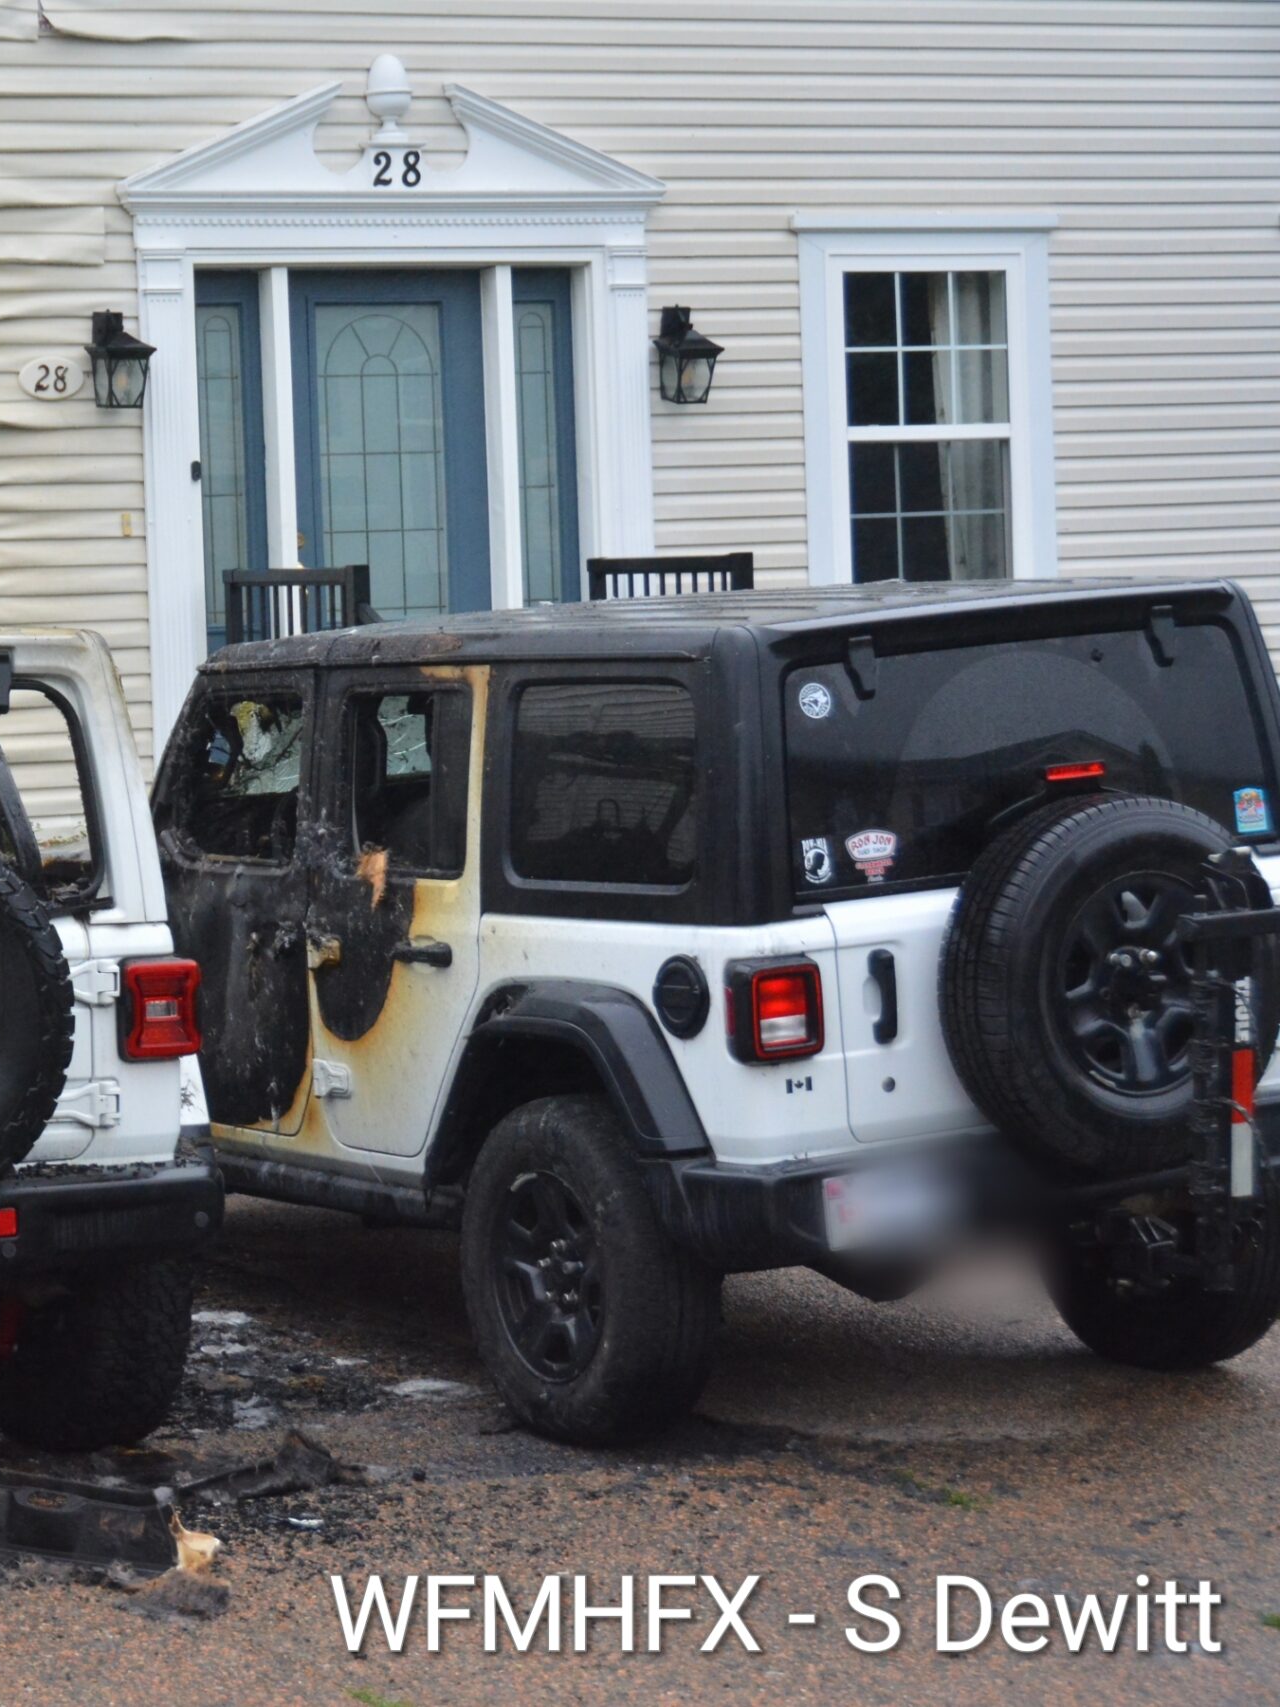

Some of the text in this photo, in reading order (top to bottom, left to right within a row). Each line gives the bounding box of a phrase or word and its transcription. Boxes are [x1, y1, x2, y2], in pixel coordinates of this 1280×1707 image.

[373, 150, 421, 187] 28
[34, 364, 68, 393] 28
[851, 834, 892, 851] RON JON
